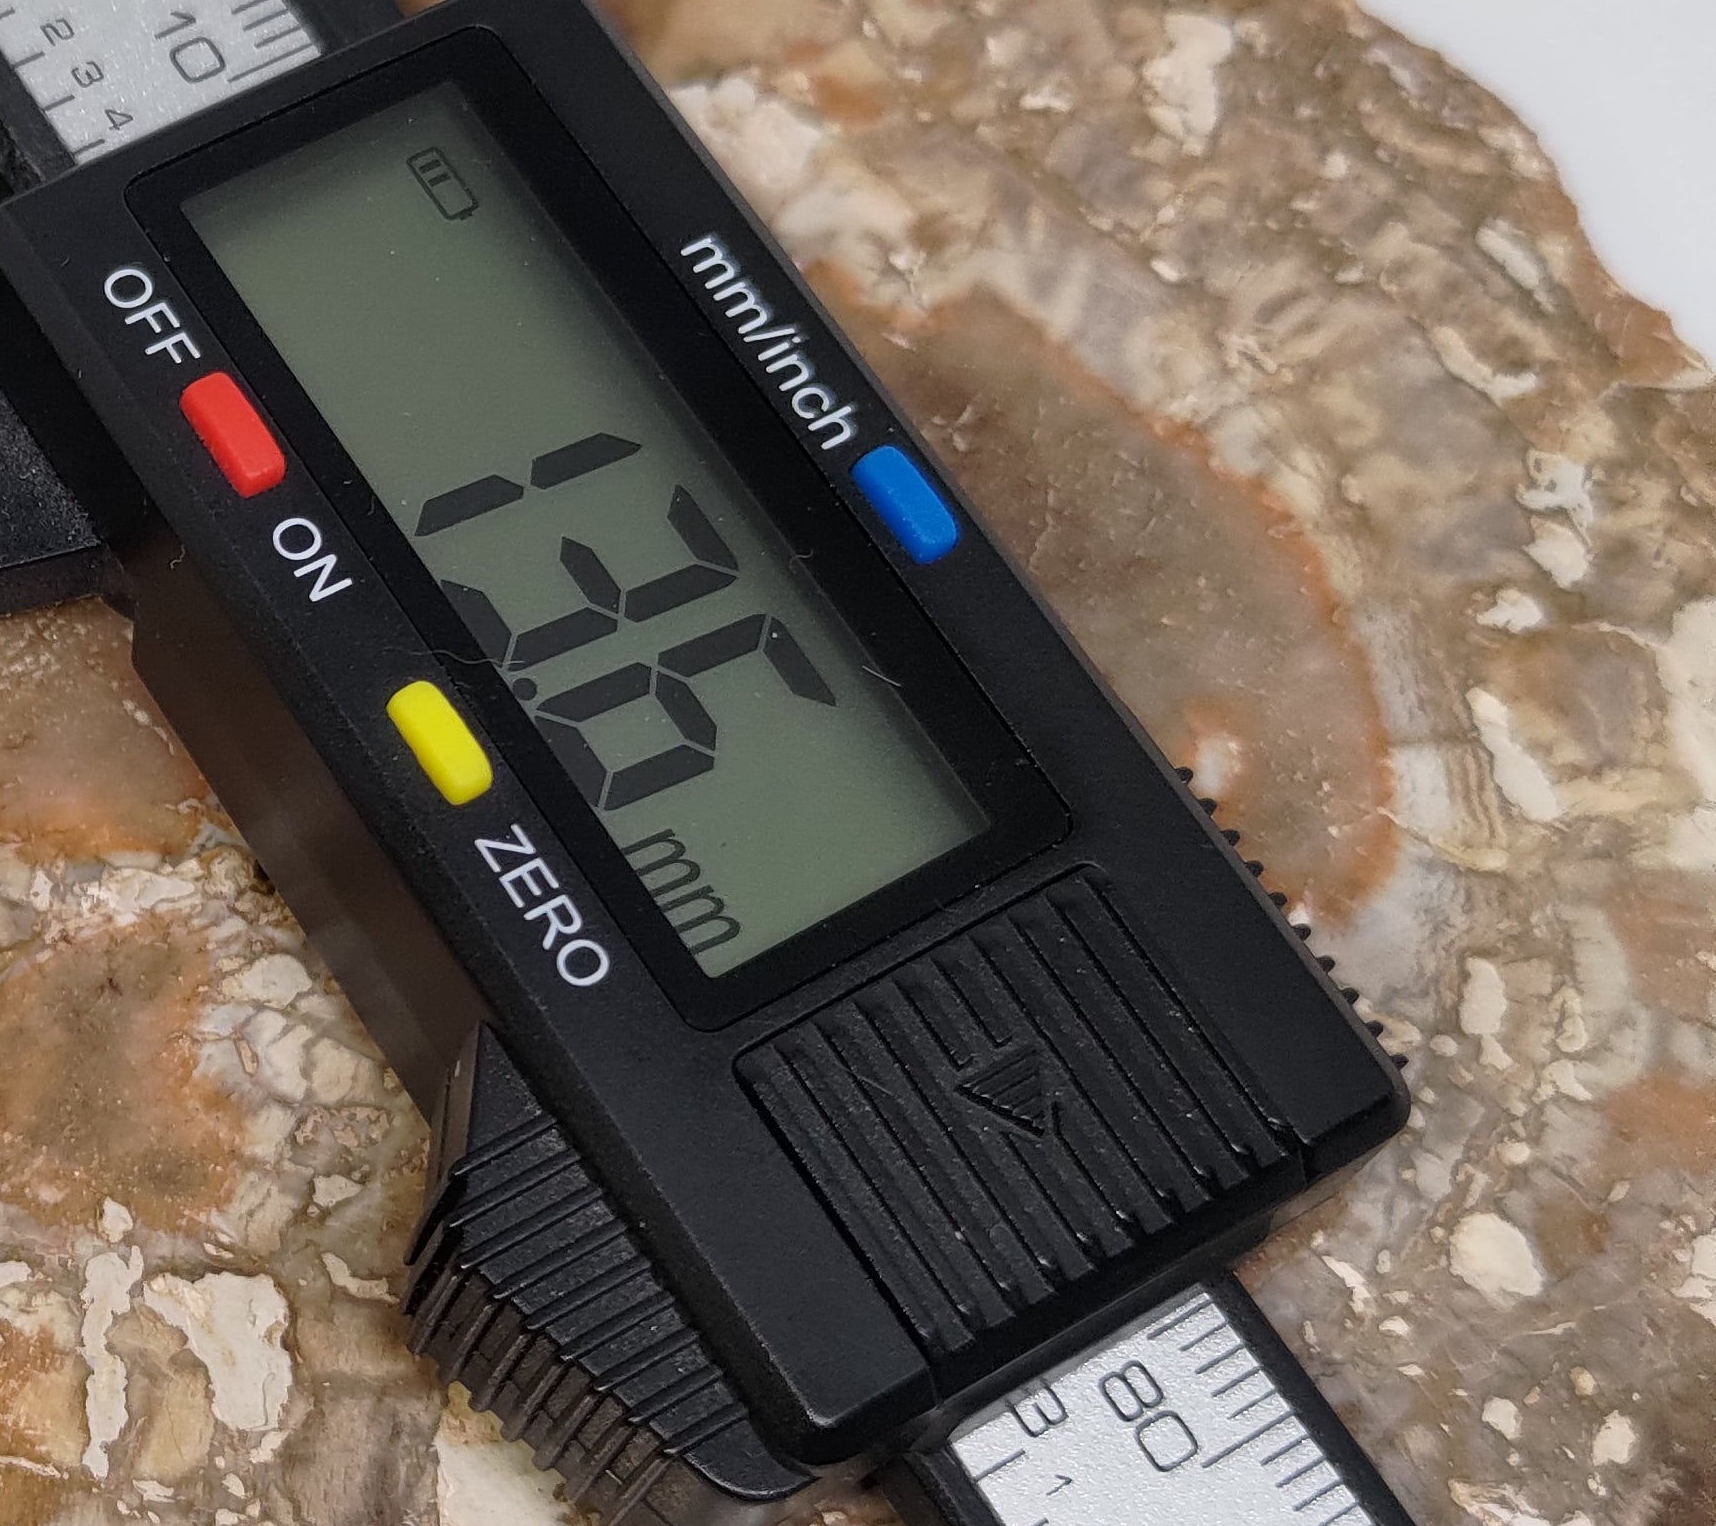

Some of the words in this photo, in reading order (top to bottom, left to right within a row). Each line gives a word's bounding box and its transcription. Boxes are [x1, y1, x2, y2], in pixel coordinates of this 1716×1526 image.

[40, 17, 75, 47] 2
[70, 60, 104, 88] 3
[104, 108, 134, 131] 4
[154, 10, 226, 84] 10
[103, 264, 202, 366] OFF
[681, 234, 859, 454] mm/inch
[271, 516, 353, 604] ON
[414, 432, 838, 810] 13.6
[473, 822, 610, 988] ZERO
[625, 827, 743, 957] mm
[1005, 1377, 1069, 1438] 3
[1046, 1473, 1073, 1496] 1
[1098, 1359, 1199, 1472] 80
